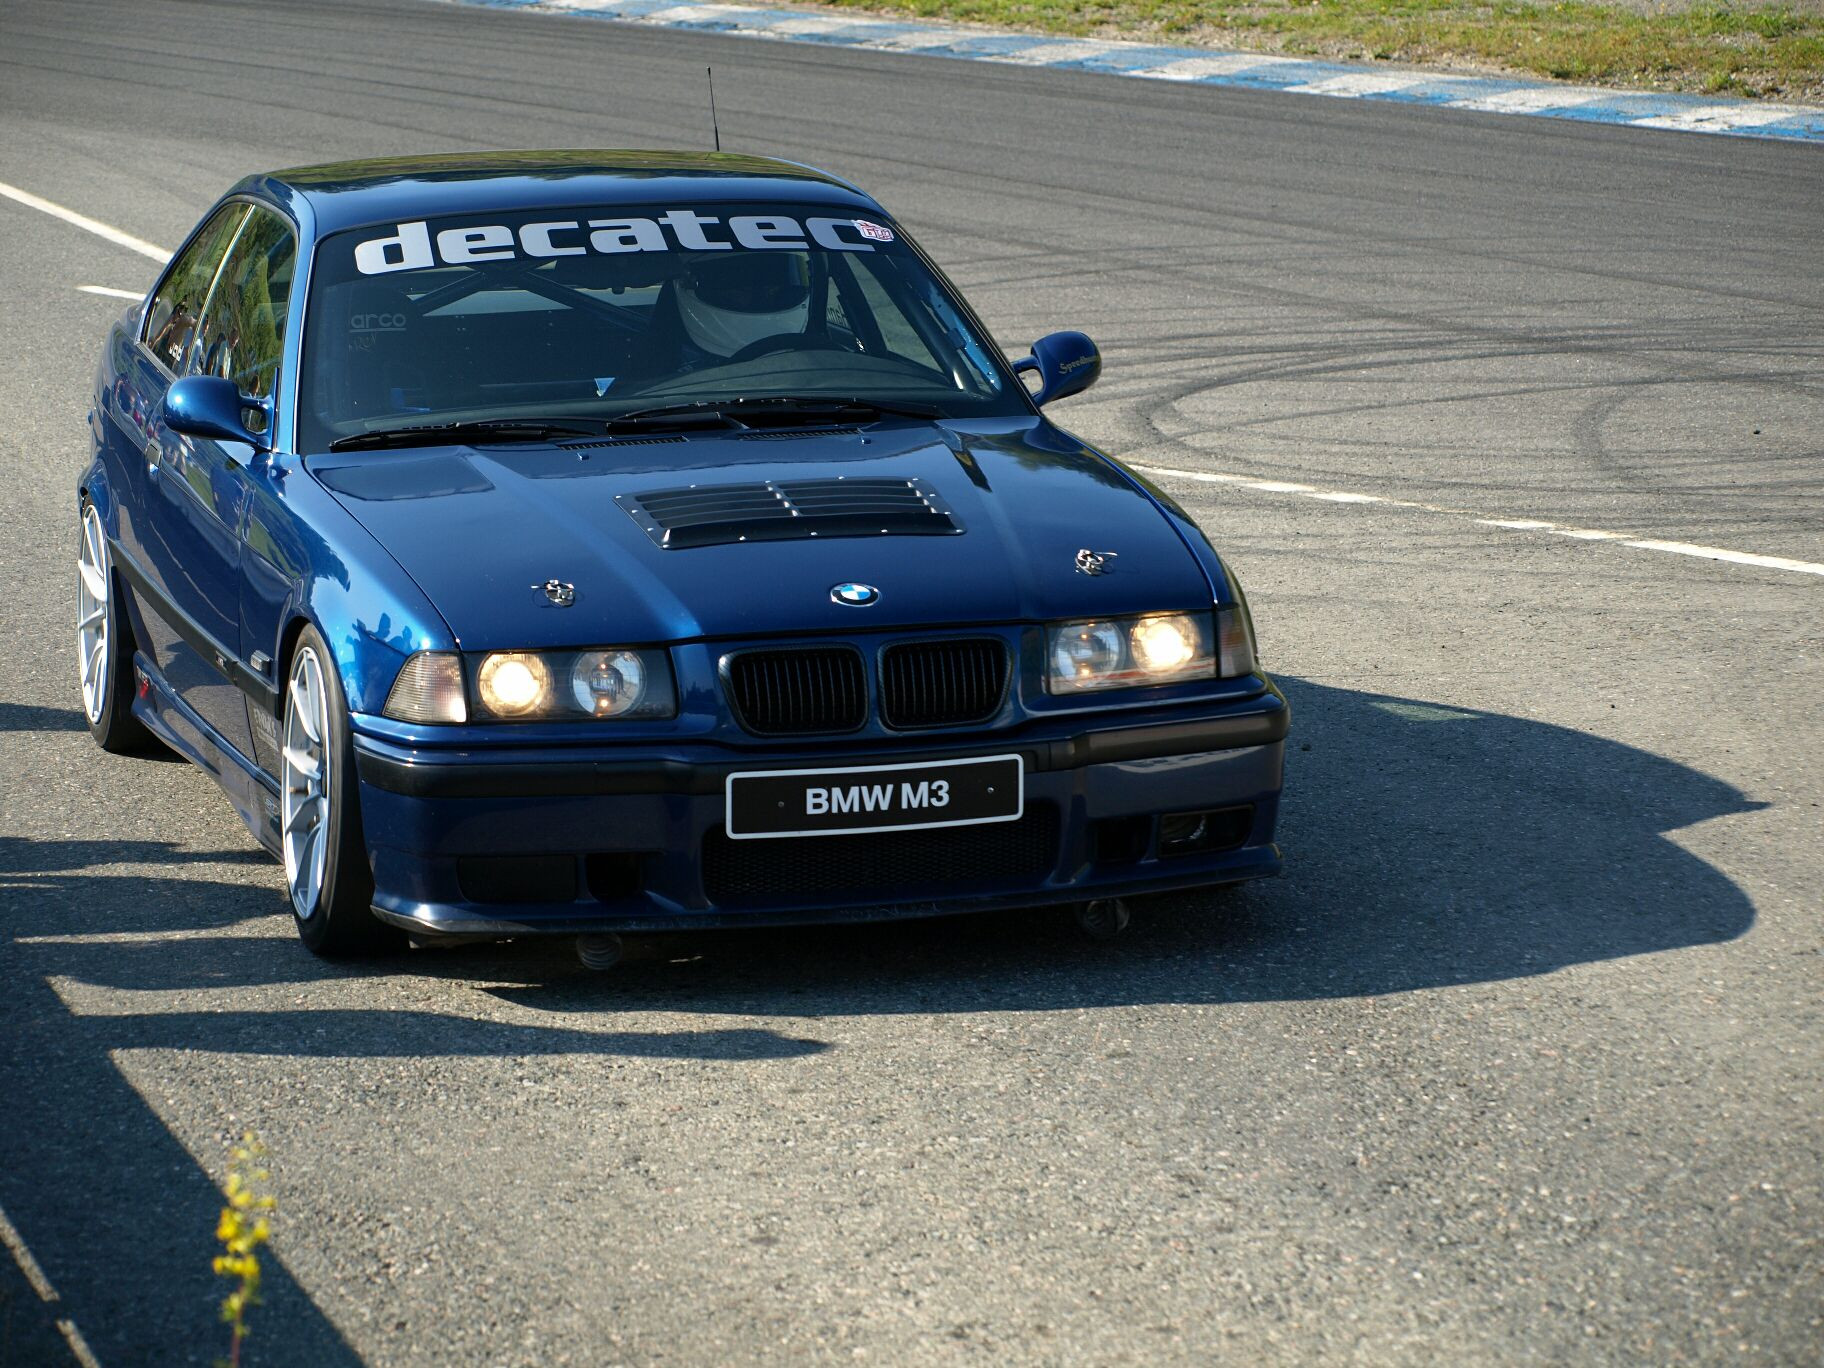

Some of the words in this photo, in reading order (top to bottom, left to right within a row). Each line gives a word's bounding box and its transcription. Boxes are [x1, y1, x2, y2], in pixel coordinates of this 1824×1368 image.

[355, 210, 876, 275] decatec
[350, 312, 407, 329] arco
[805, 784, 894, 815] BMW
[900, 779, 950, 809] M3
